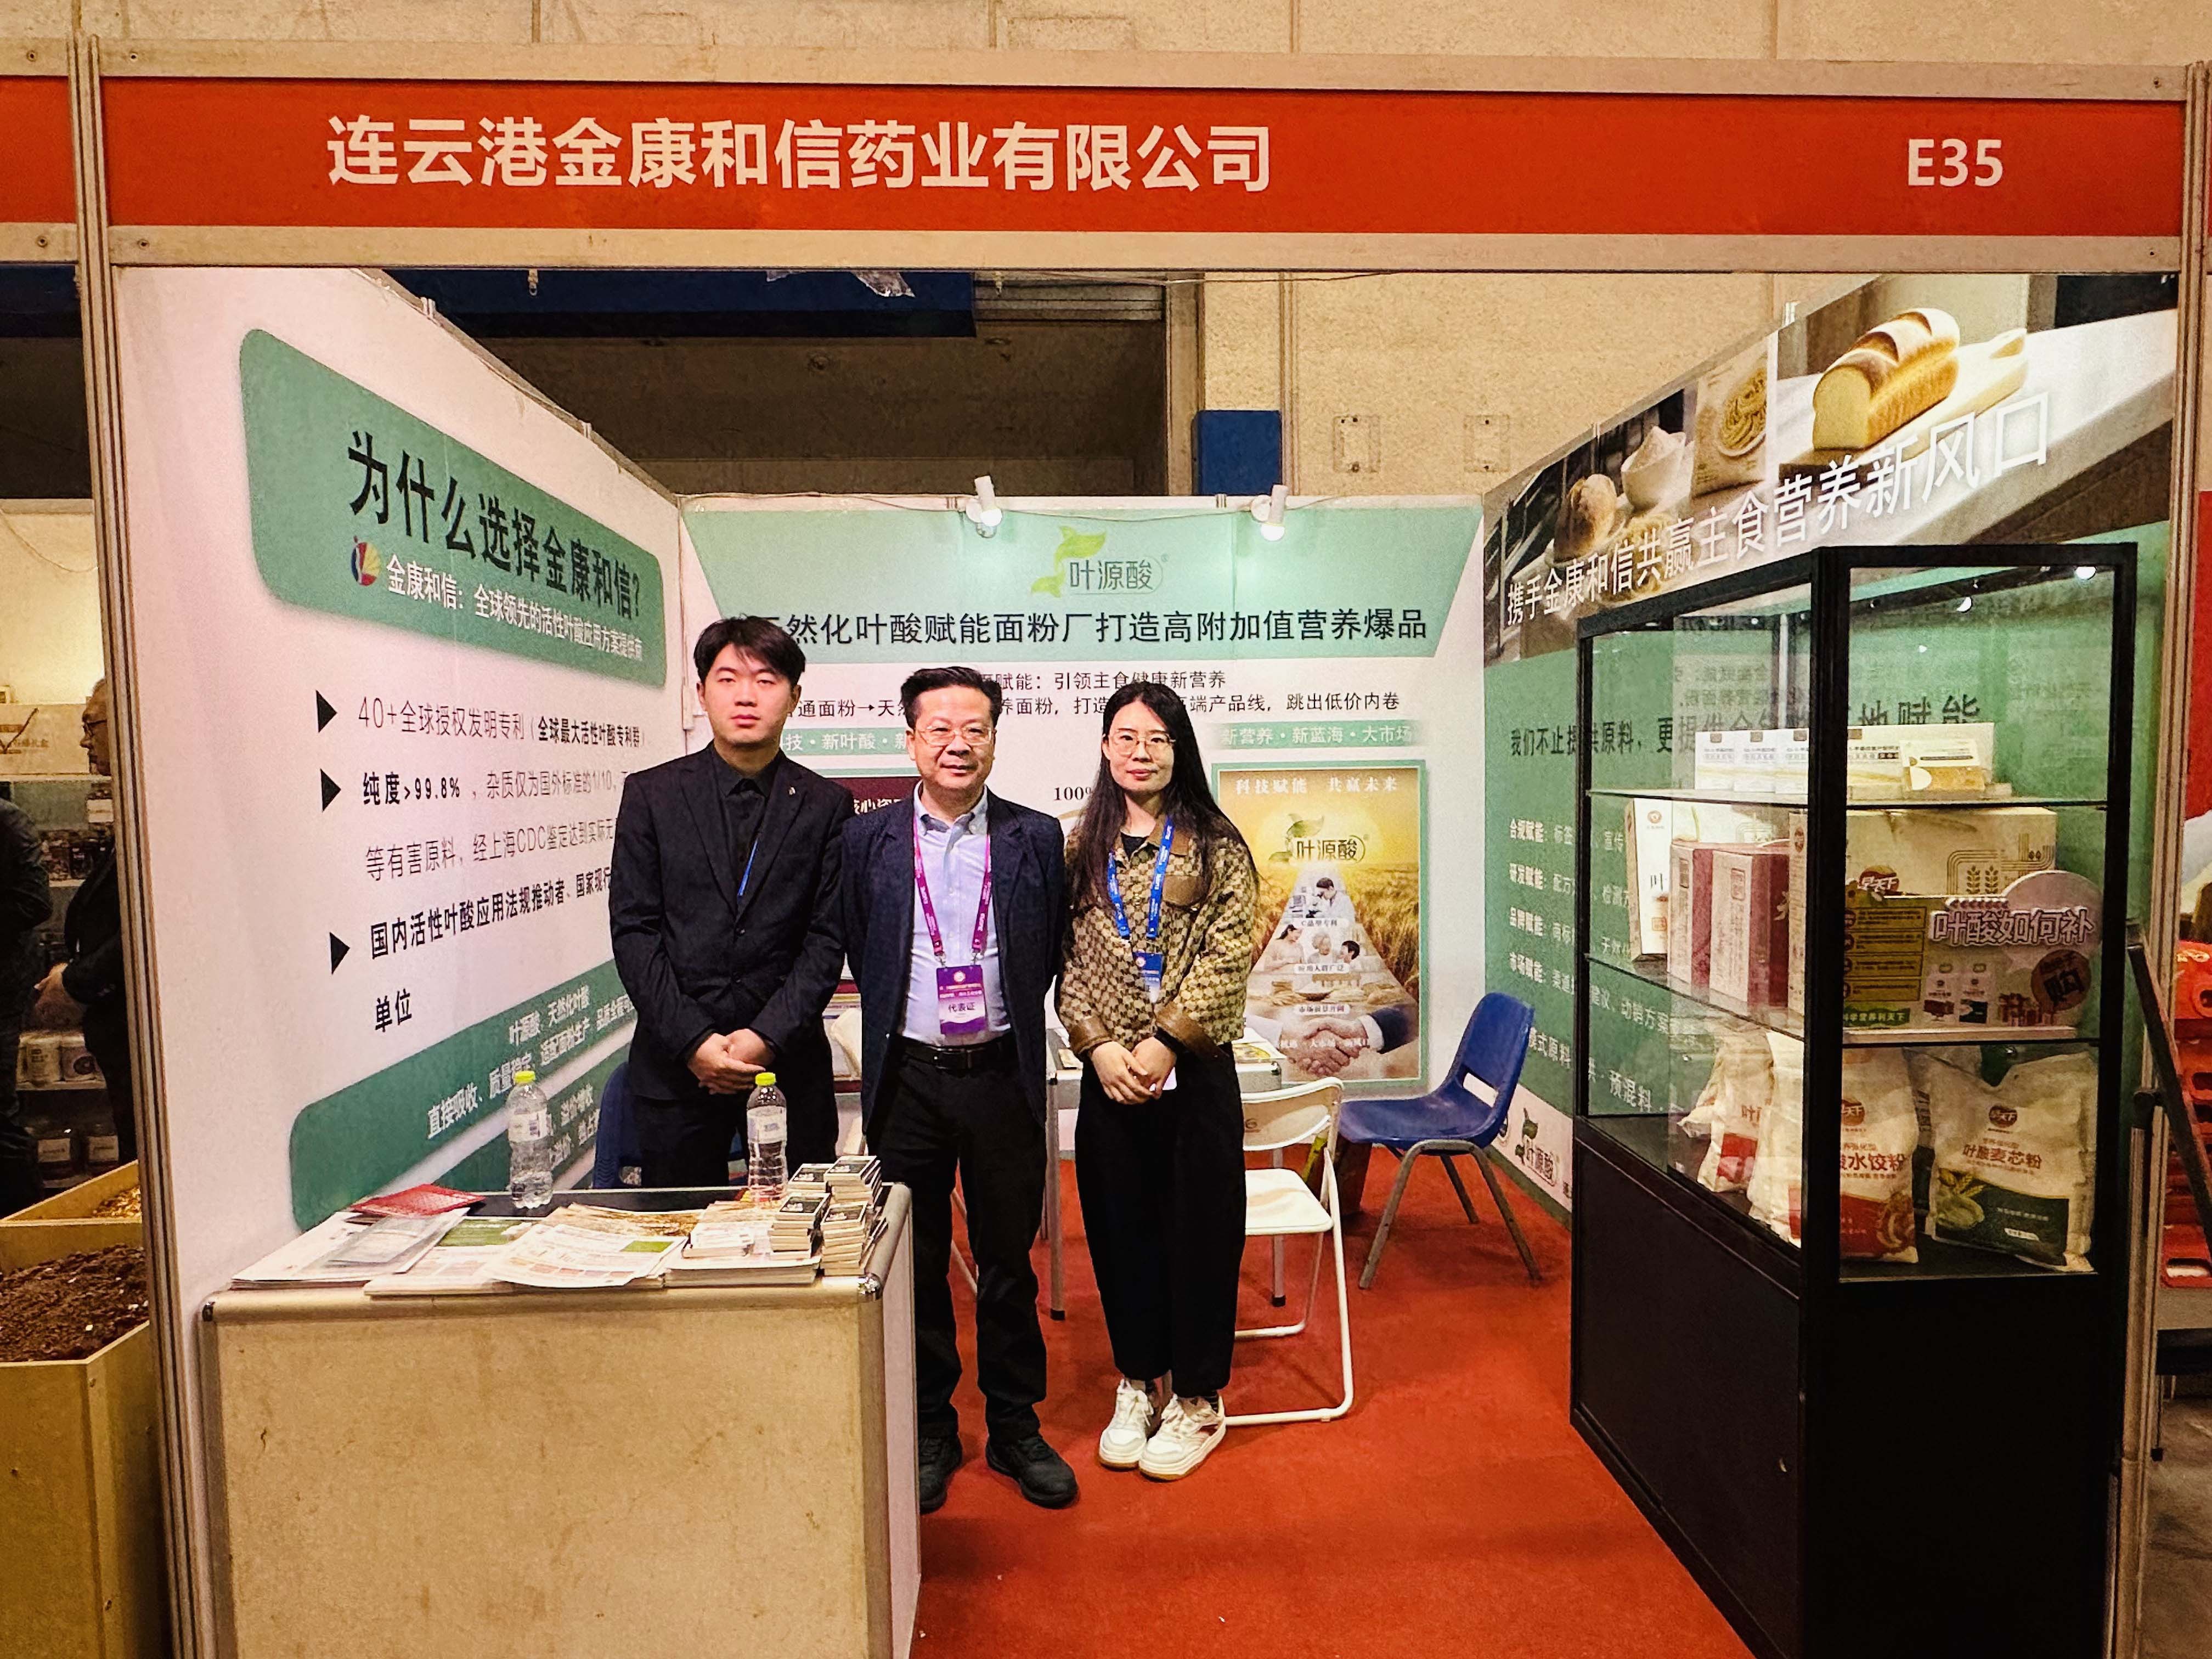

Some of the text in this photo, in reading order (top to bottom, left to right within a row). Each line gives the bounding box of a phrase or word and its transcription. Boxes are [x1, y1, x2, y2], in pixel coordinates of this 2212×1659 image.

[328, 115, 1269, 192] 连云港金康和信药业有限公司
[1908, 138, 2003, 187] E35
[1506, 391, 2048, 626] 携手金康和信共赢主食营养新风口
[1069, 559, 1154, 591] 叶源酸
[764, 608, 1427, 645] 然化叶酸赋能面粉厂打造高附加值营养爆品
[1236, 776, 1398, 795] 科技赋能 共赢未来
[1296, 839, 1358, 861] 叶源酸
[1932, 908, 2094, 944] 叶酸如何补
[375, 988, 413, 1032] 单位
[1962, 1144, 2042, 1170] 叶酸麦芯粉
